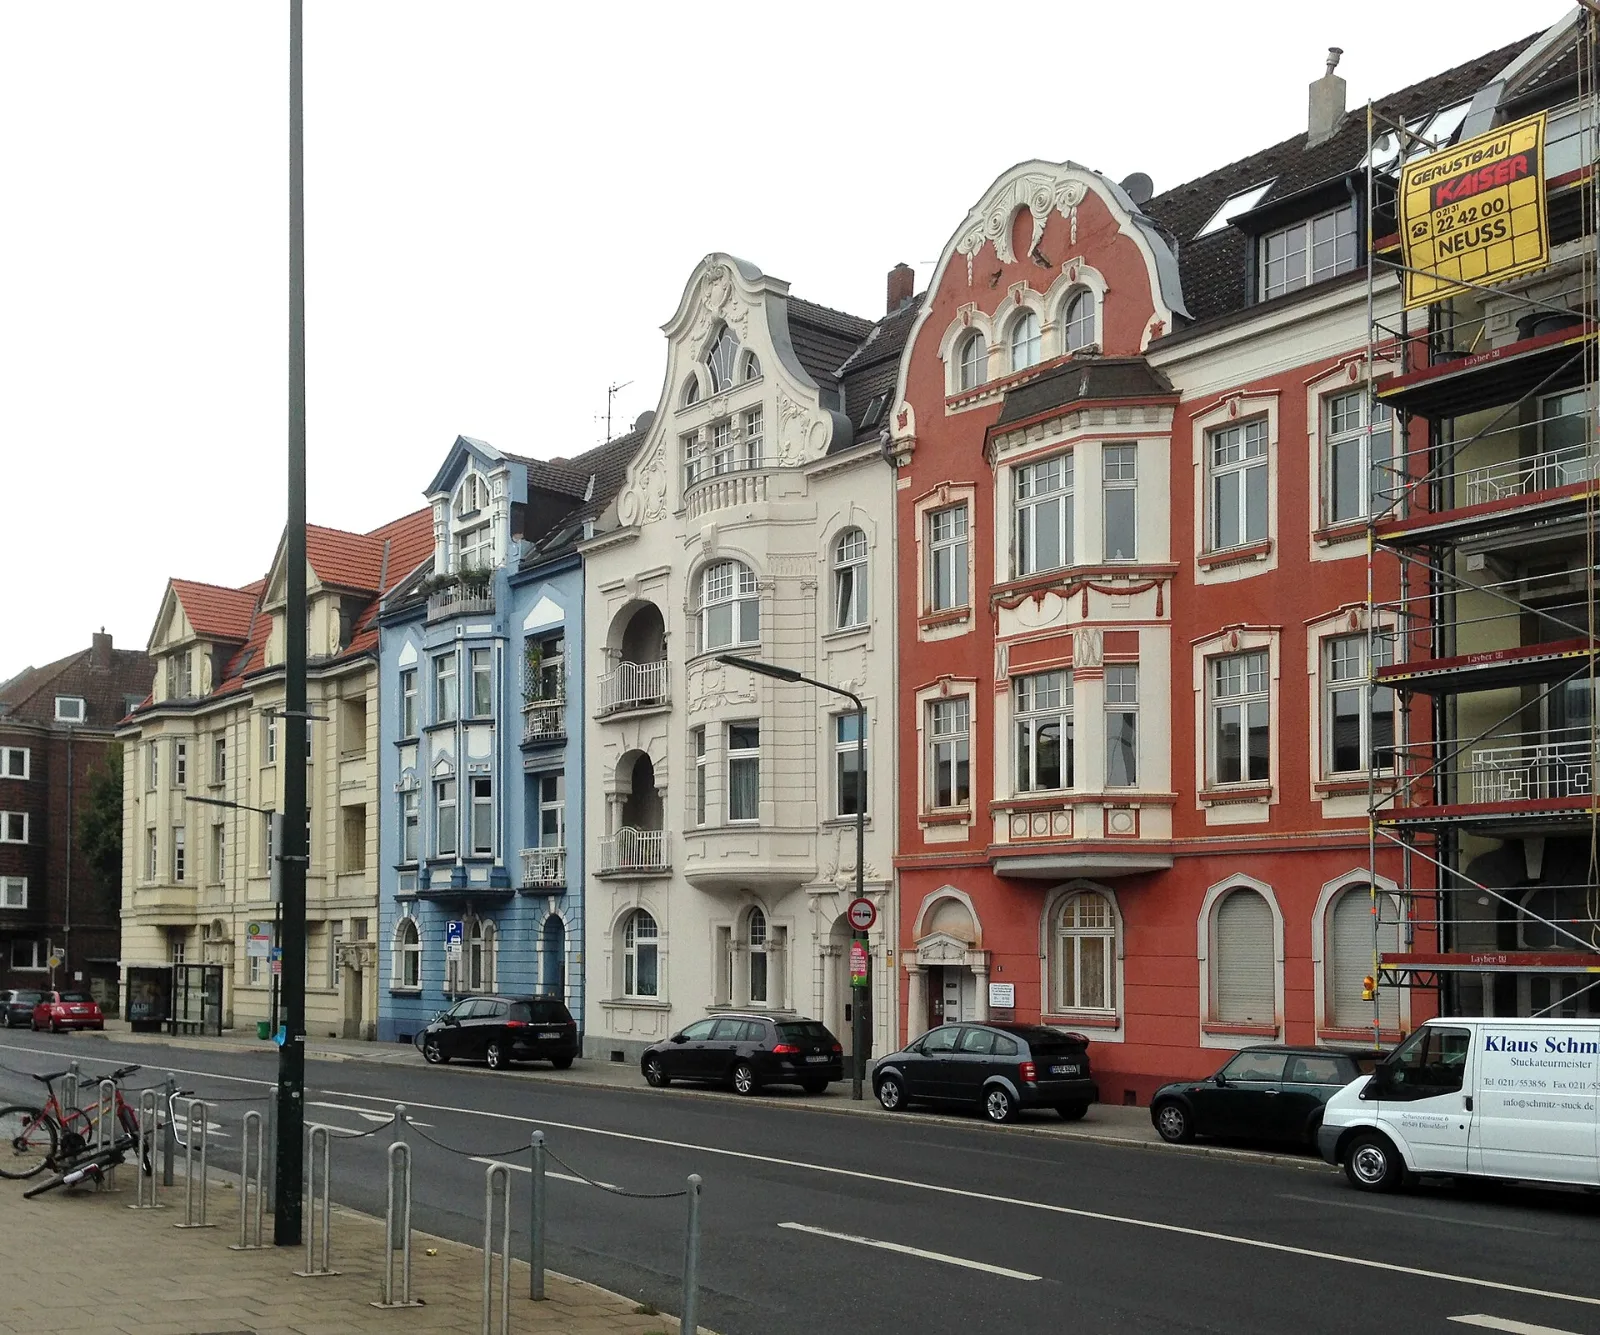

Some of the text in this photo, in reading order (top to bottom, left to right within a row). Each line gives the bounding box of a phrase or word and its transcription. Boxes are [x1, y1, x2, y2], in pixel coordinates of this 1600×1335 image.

[1436, 154, 1528, 207] KAISER
[1437, 198, 1504, 233] 22 42 00
[1439, 218, 1506, 258] NEUSS
[448, 923, 456, 933] P
[1484, 1035, 1598, 1054] Klaus Schm
[1510, 1057, 1592, 1069] Stuckateurmeister
[1498, 1079, 1546, 1088] 0211/553856
